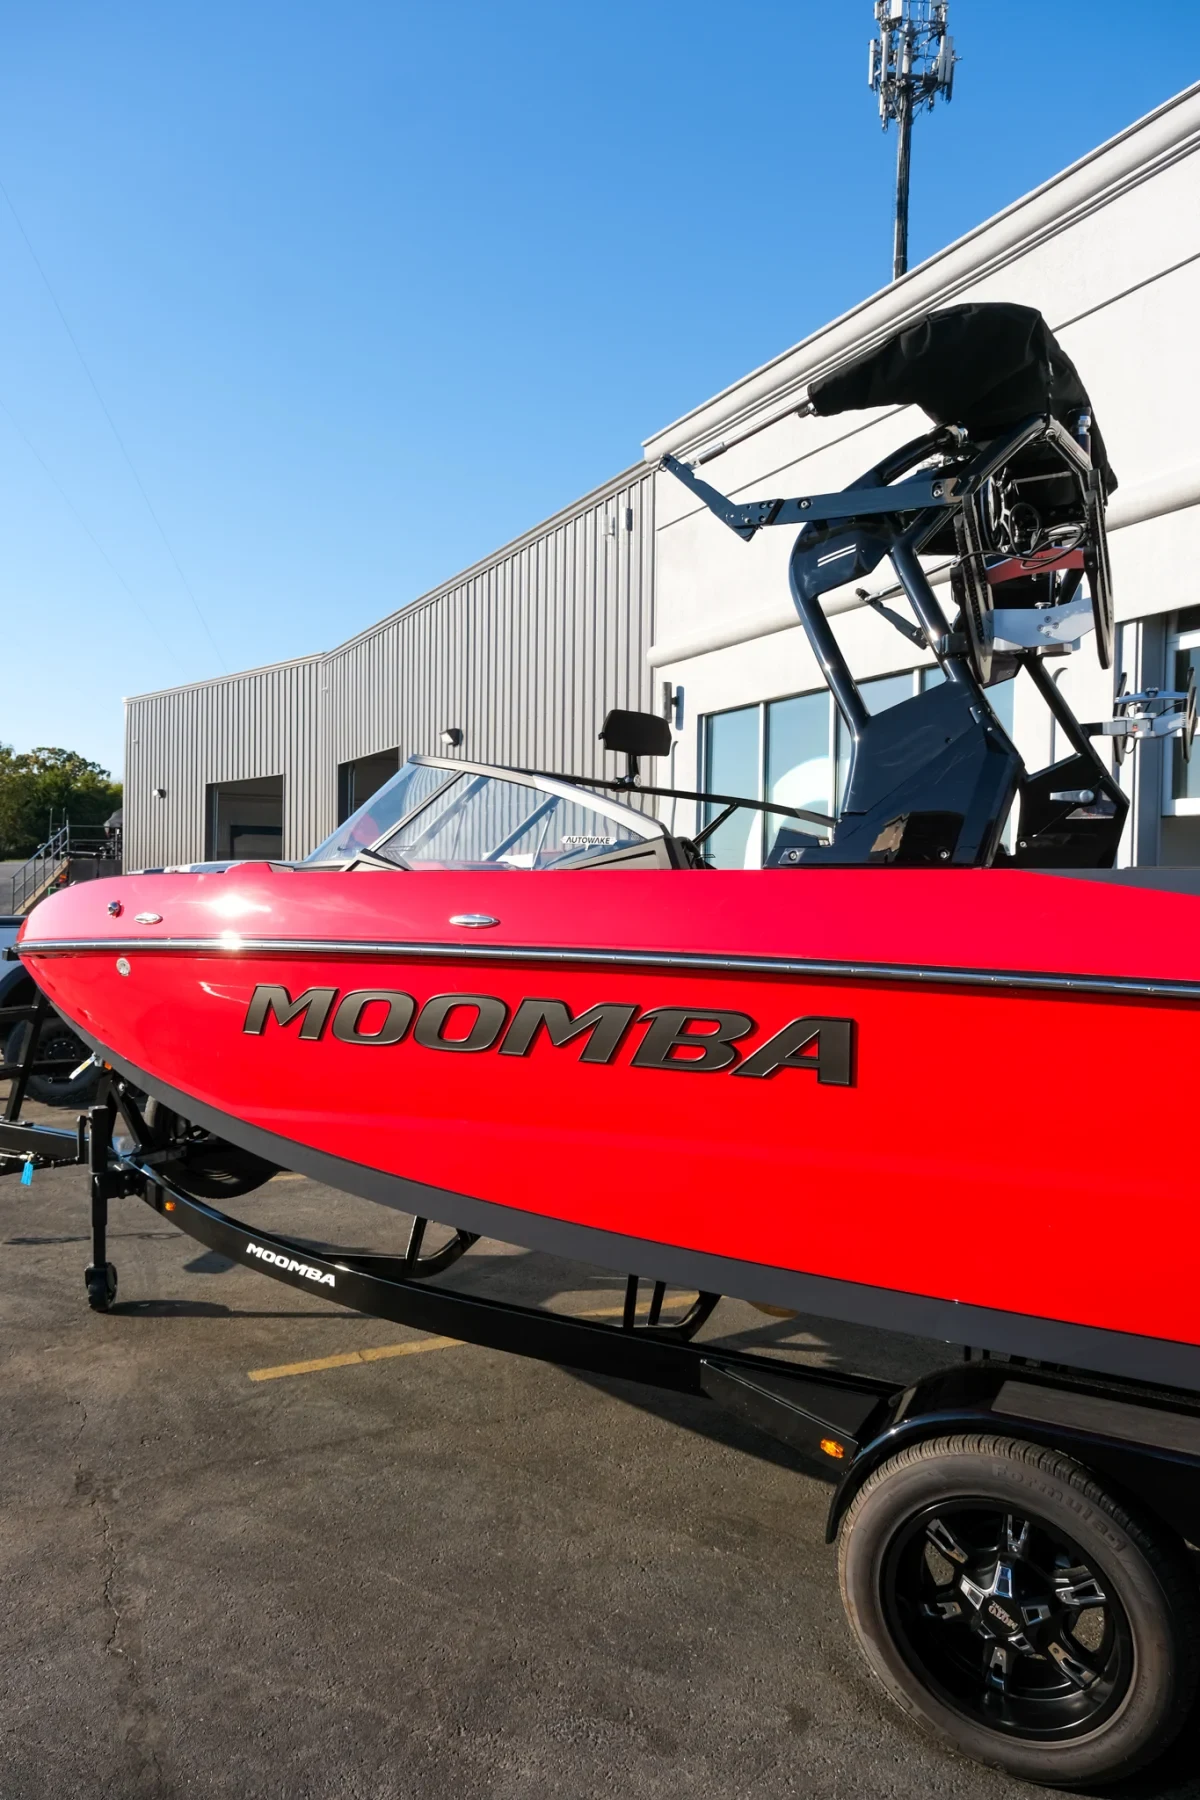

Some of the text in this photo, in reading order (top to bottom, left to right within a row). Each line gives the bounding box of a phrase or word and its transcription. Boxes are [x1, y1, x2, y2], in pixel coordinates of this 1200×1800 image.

[565, 836, 611, 845] AUTOWAKE
[243, 984, 857, 1087] MOOMBA
[245, 1242, 336, 1287] MOOMBA
[988, 1605, 1019, 1631] MOTO
